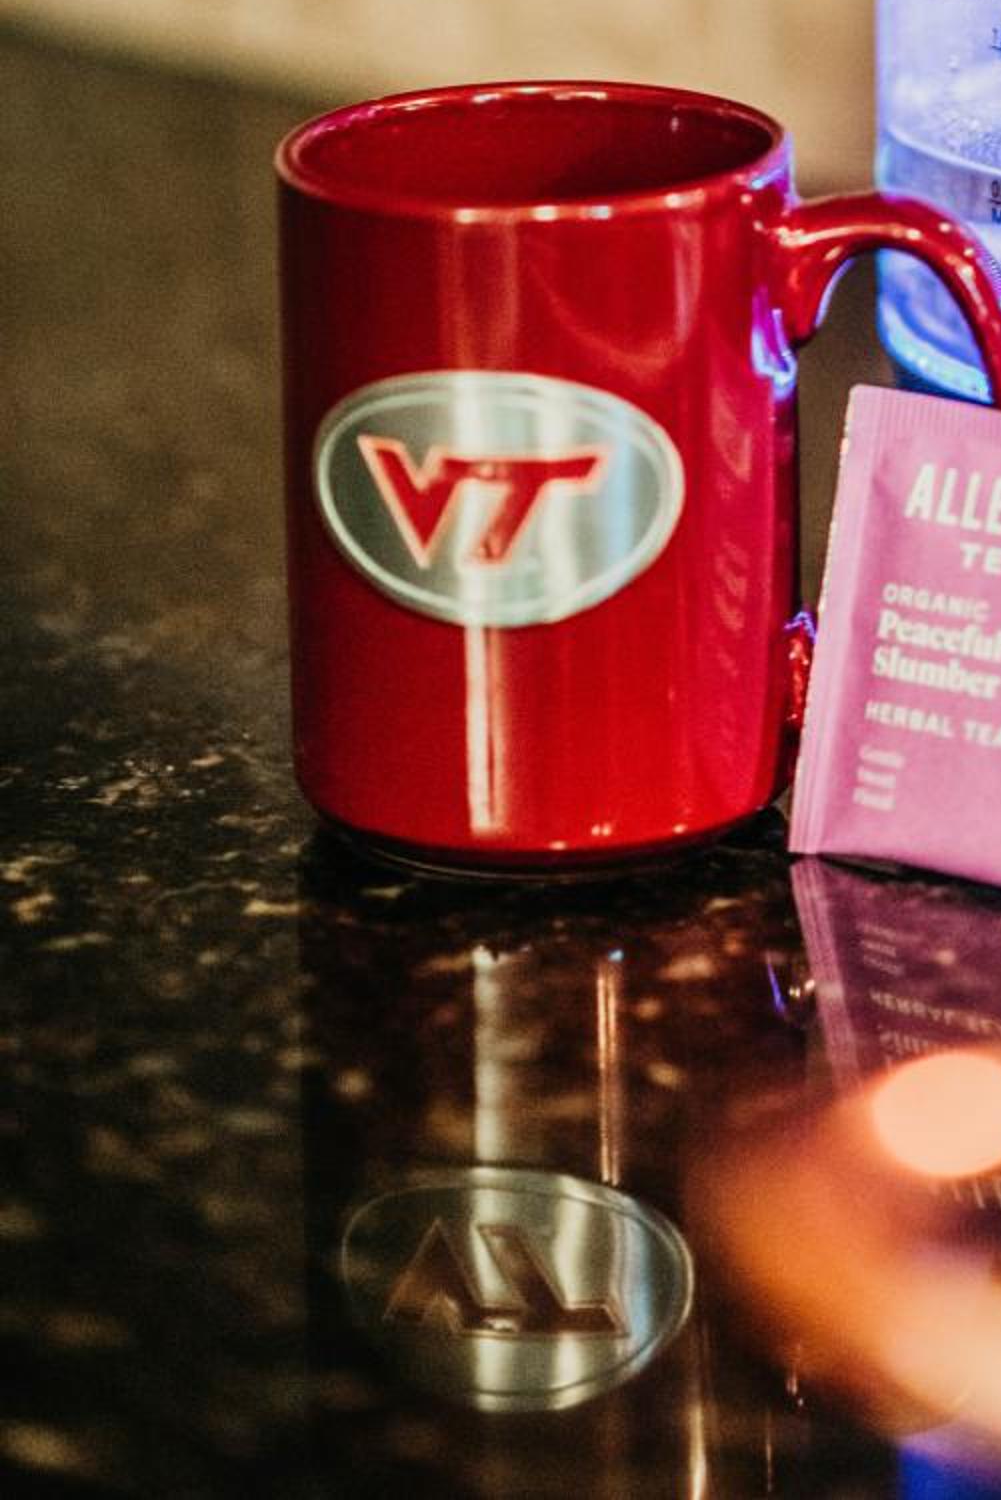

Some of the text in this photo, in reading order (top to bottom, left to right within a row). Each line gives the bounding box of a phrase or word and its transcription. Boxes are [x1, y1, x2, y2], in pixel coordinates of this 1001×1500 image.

[356, 435, 616, 569] VT
[881, 582, 991, 624] ORGANIC
[864, 700, 956, 739] HERBAL
